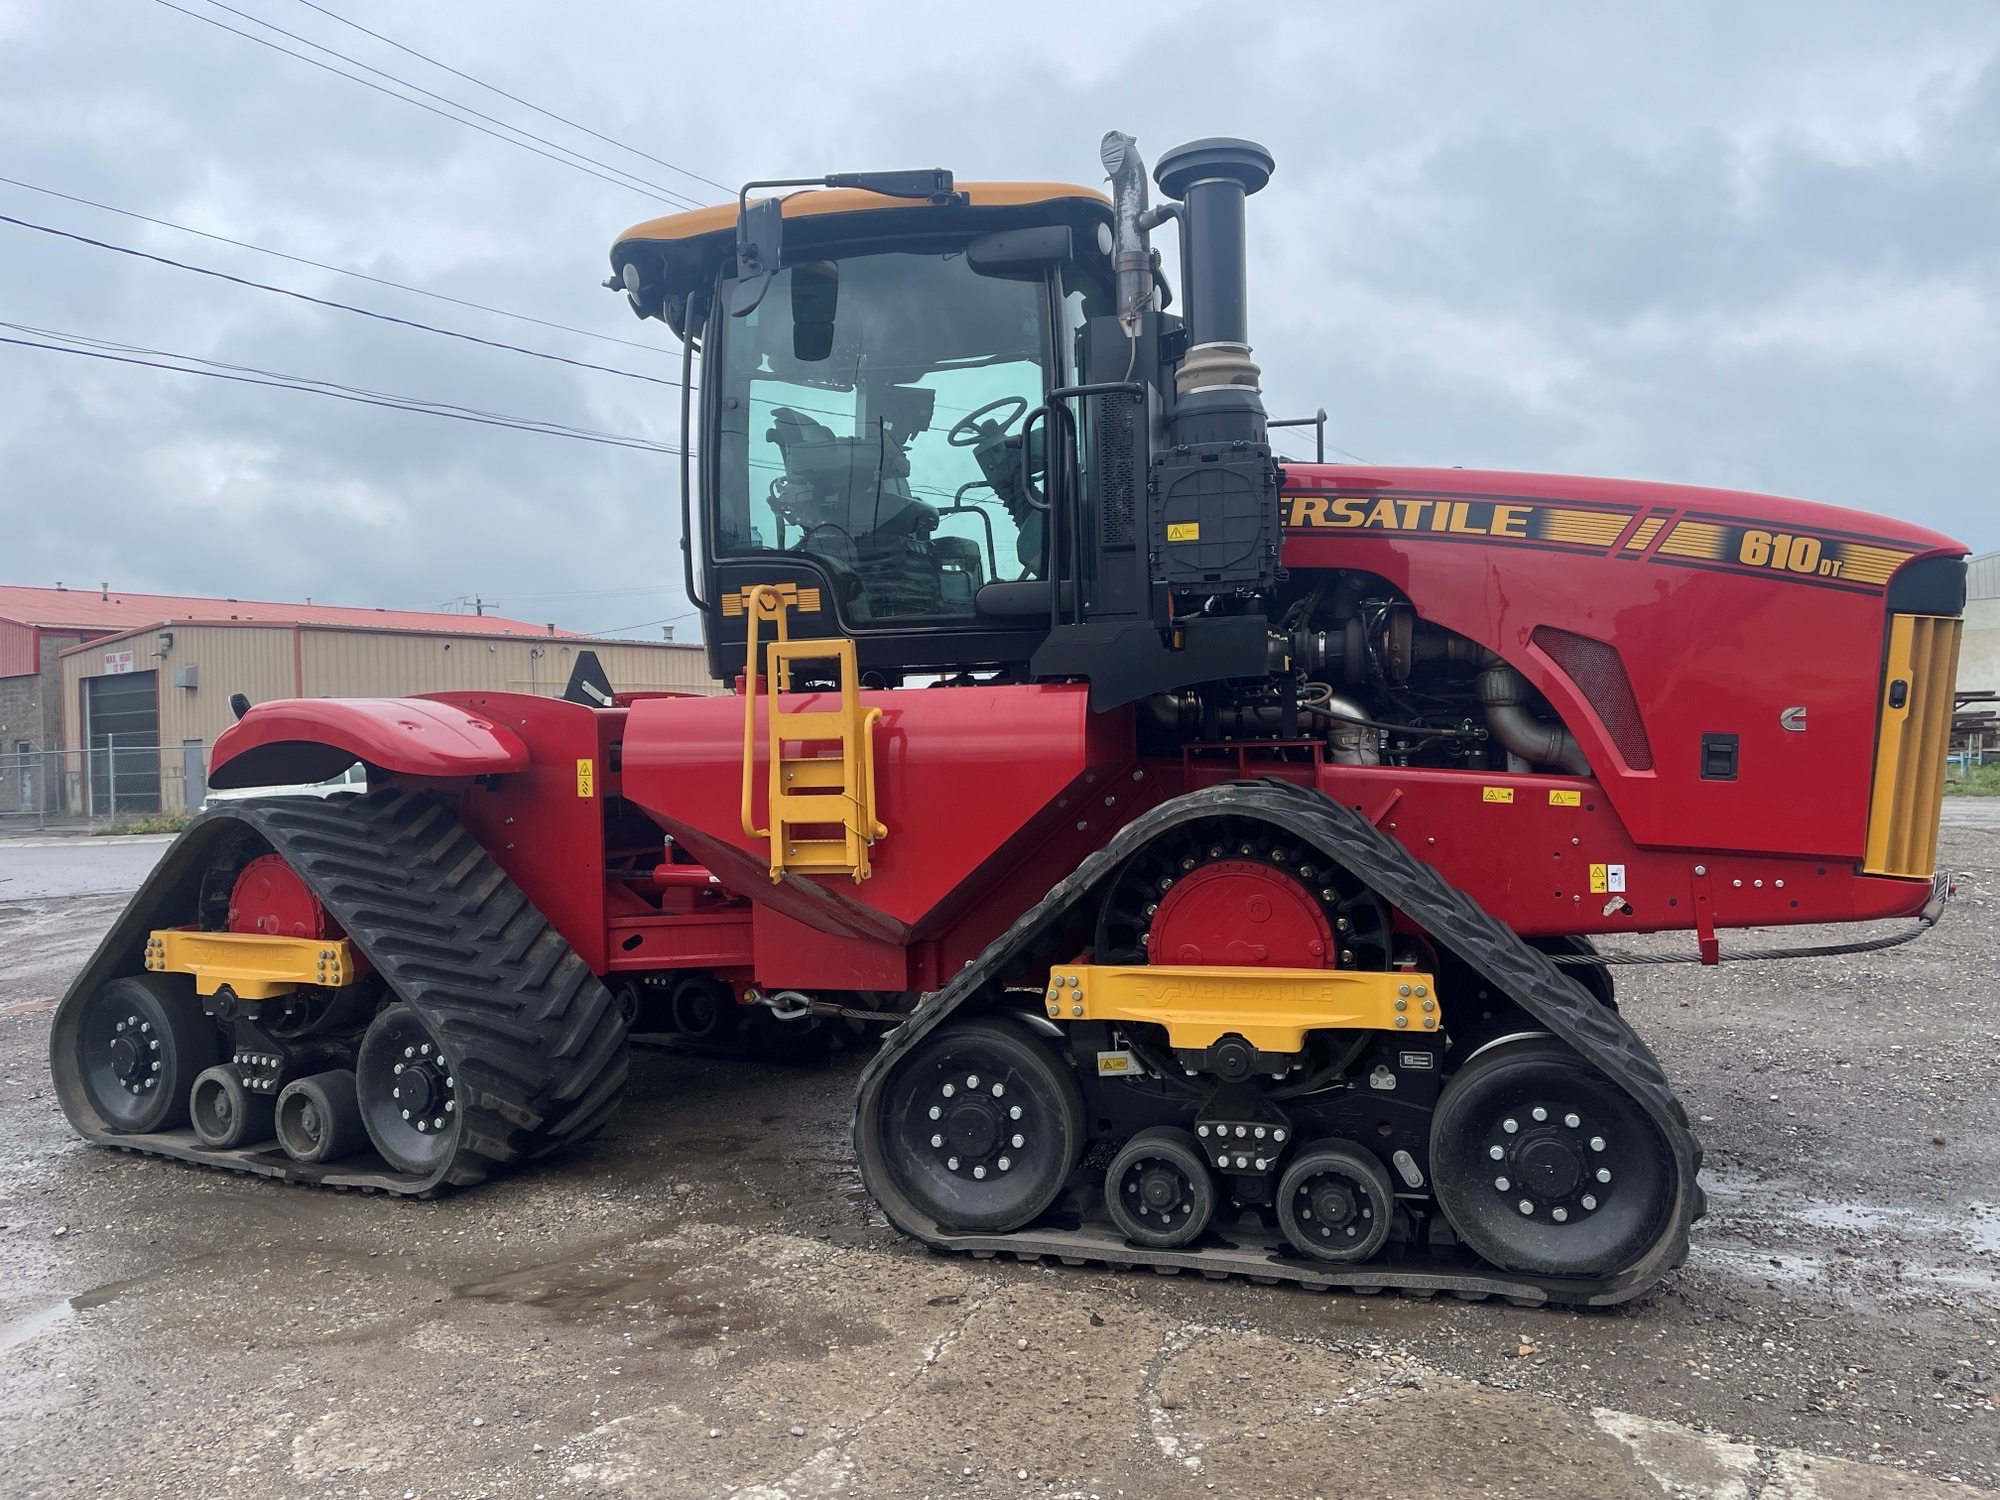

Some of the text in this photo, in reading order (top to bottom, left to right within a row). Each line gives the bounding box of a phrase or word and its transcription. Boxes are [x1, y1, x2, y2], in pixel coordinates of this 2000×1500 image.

[1739, 530, 1844, 577] 610 DT
[1182, 981, 1335, 1002] VERSATILE
